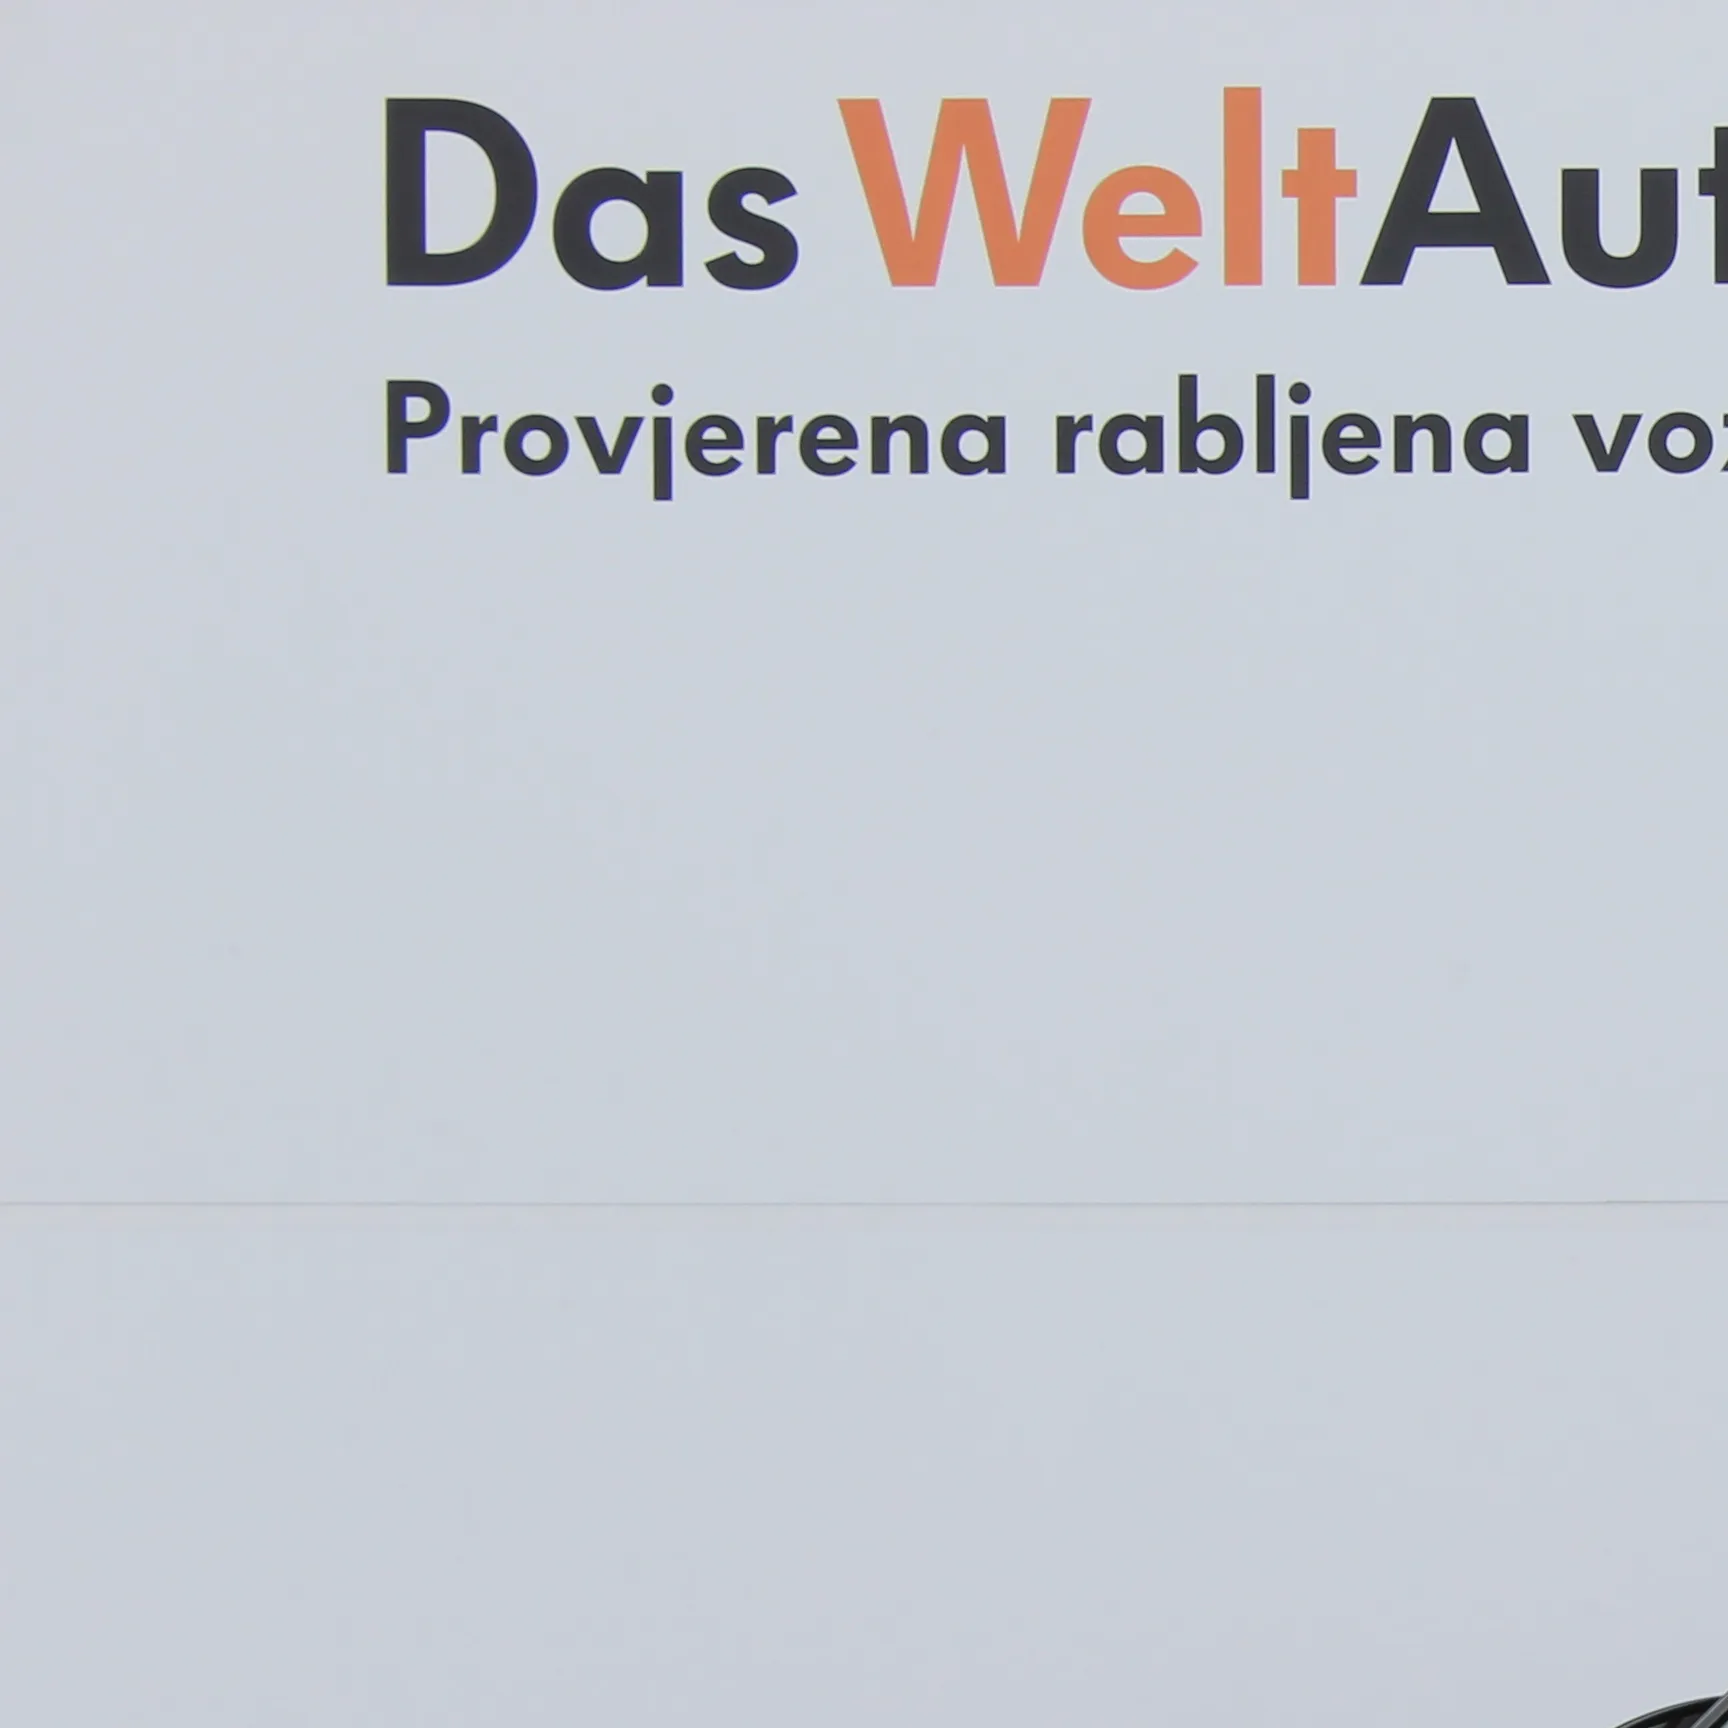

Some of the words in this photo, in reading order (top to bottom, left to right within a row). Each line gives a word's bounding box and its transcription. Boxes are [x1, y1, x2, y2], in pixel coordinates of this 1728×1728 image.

[386, 98, 798, 290] Das
[387, 380, 1005, 500] Provjerena
[1056, 374, 1528, 499] rabljena
